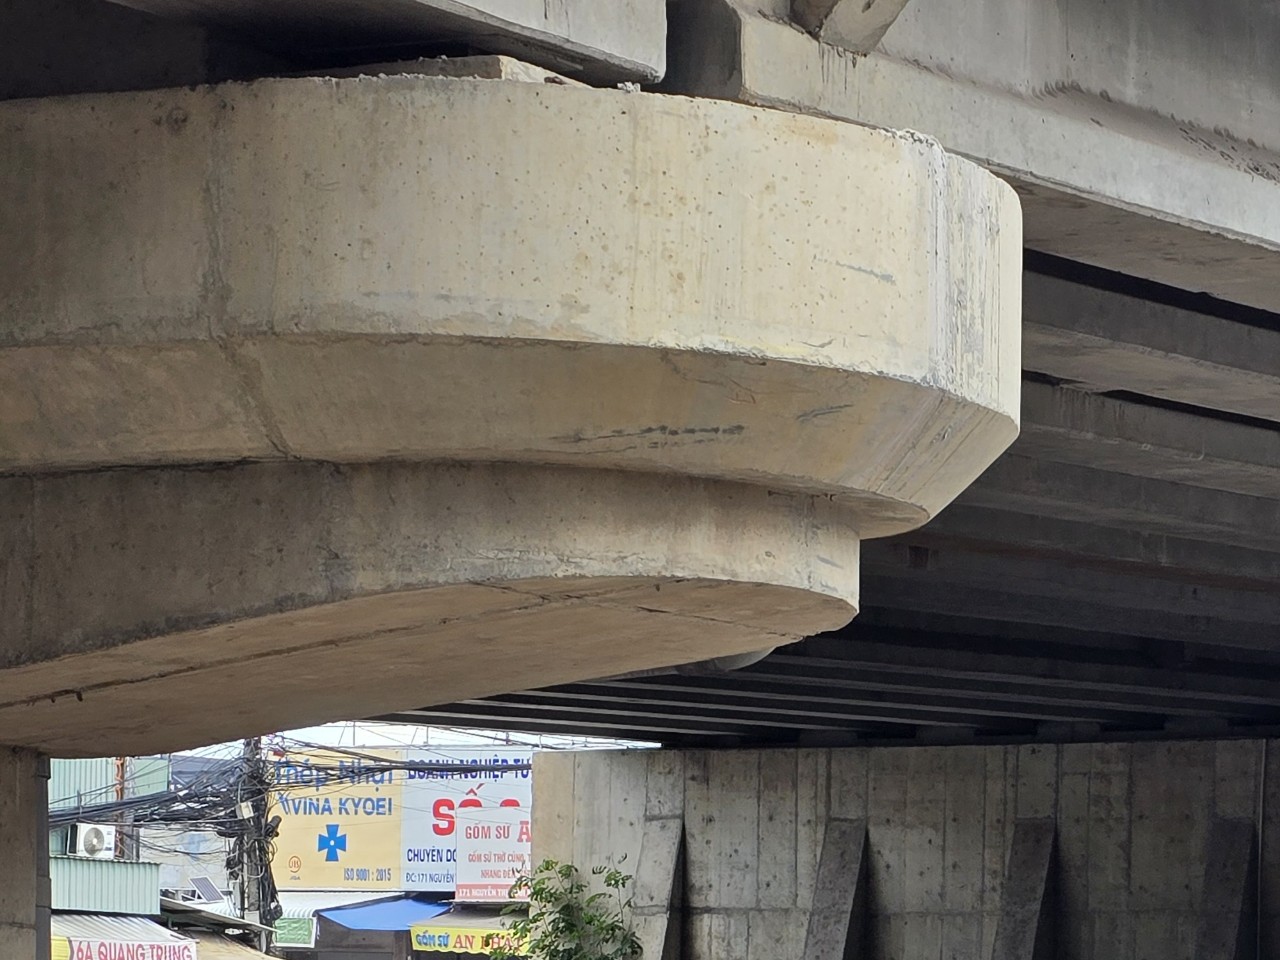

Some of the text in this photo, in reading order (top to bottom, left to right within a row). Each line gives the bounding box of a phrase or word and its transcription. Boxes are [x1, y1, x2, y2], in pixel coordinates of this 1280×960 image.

[408, 760, 455, 779] DOANH
[460, 754, 508, 783] NGHIỆP
[293, 797, 393, 816] VINA KYOEI
[407, 846, 443, 863] CHUYÊN
[344, 868, 354, 881] ISO
[356, 868, 370, 881] 9001
[376, 868, 391, 881] 2015
[416, 930, 437, 947] GỐM
[453, 934, 476, 949] AN
